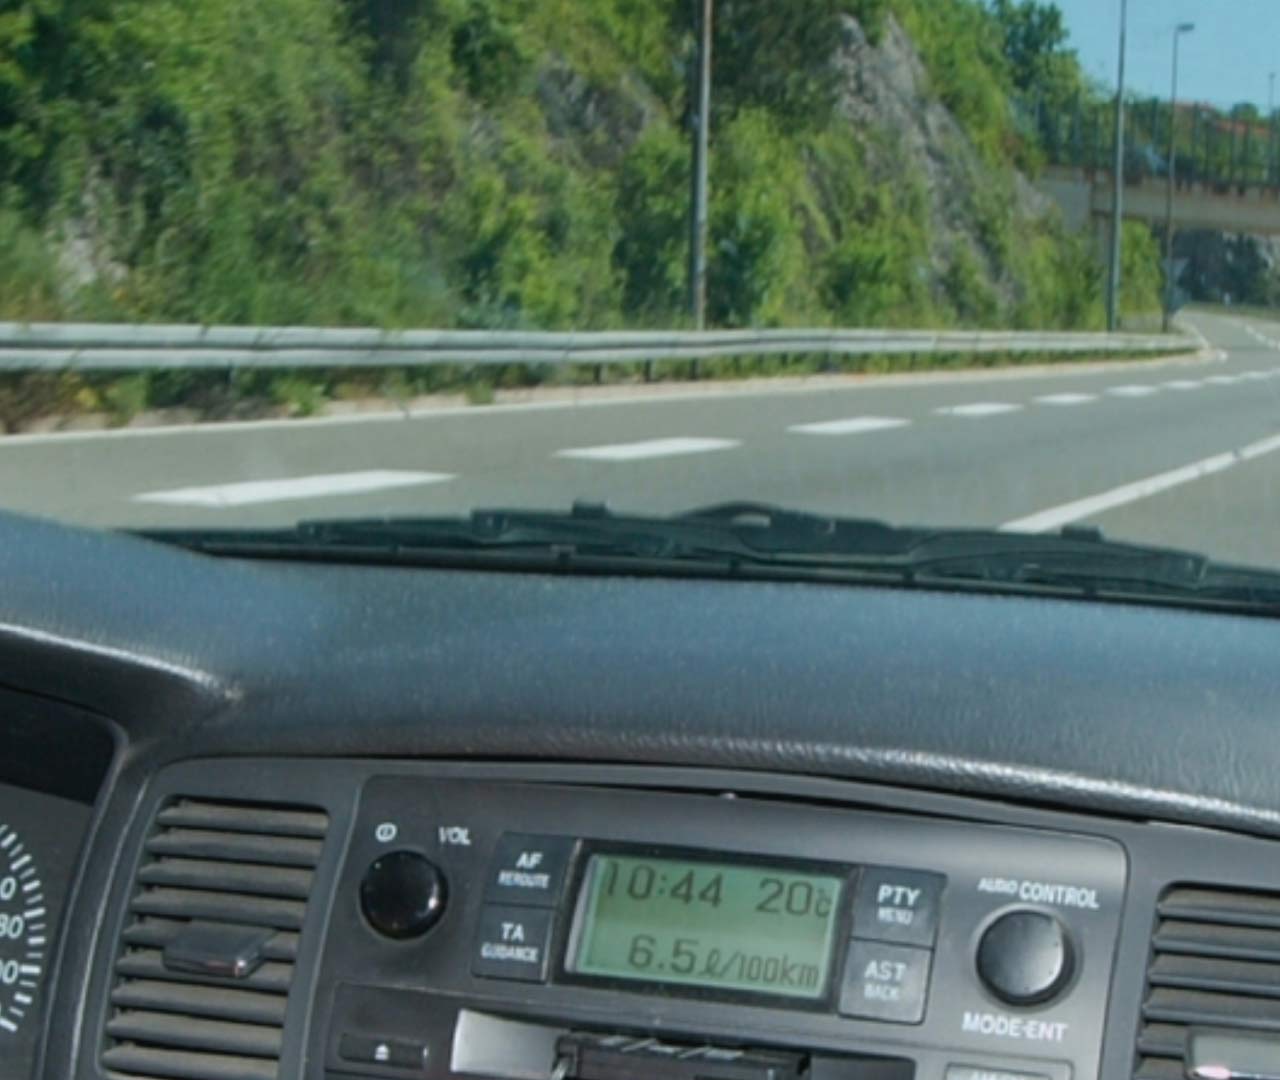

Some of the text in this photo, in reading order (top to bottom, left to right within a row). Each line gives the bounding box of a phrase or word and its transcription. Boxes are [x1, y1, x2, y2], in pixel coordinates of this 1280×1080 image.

[438, 826, 471, 846] VOL
[515, 851, 544, 870] AF
[604, 861, 724, 909] 10:44
[978, 876, 1100, 909] AUDIO CONTROL
[877, 884, 922, 907] PTY
[877, 906, 914, 926] MENU
[501, 922, 525, 942] TA
[480, 942, 540, 963] GUIDANCE
[864, 960, 907, 982] AST
[863, 984, 900, 1001] BACK
